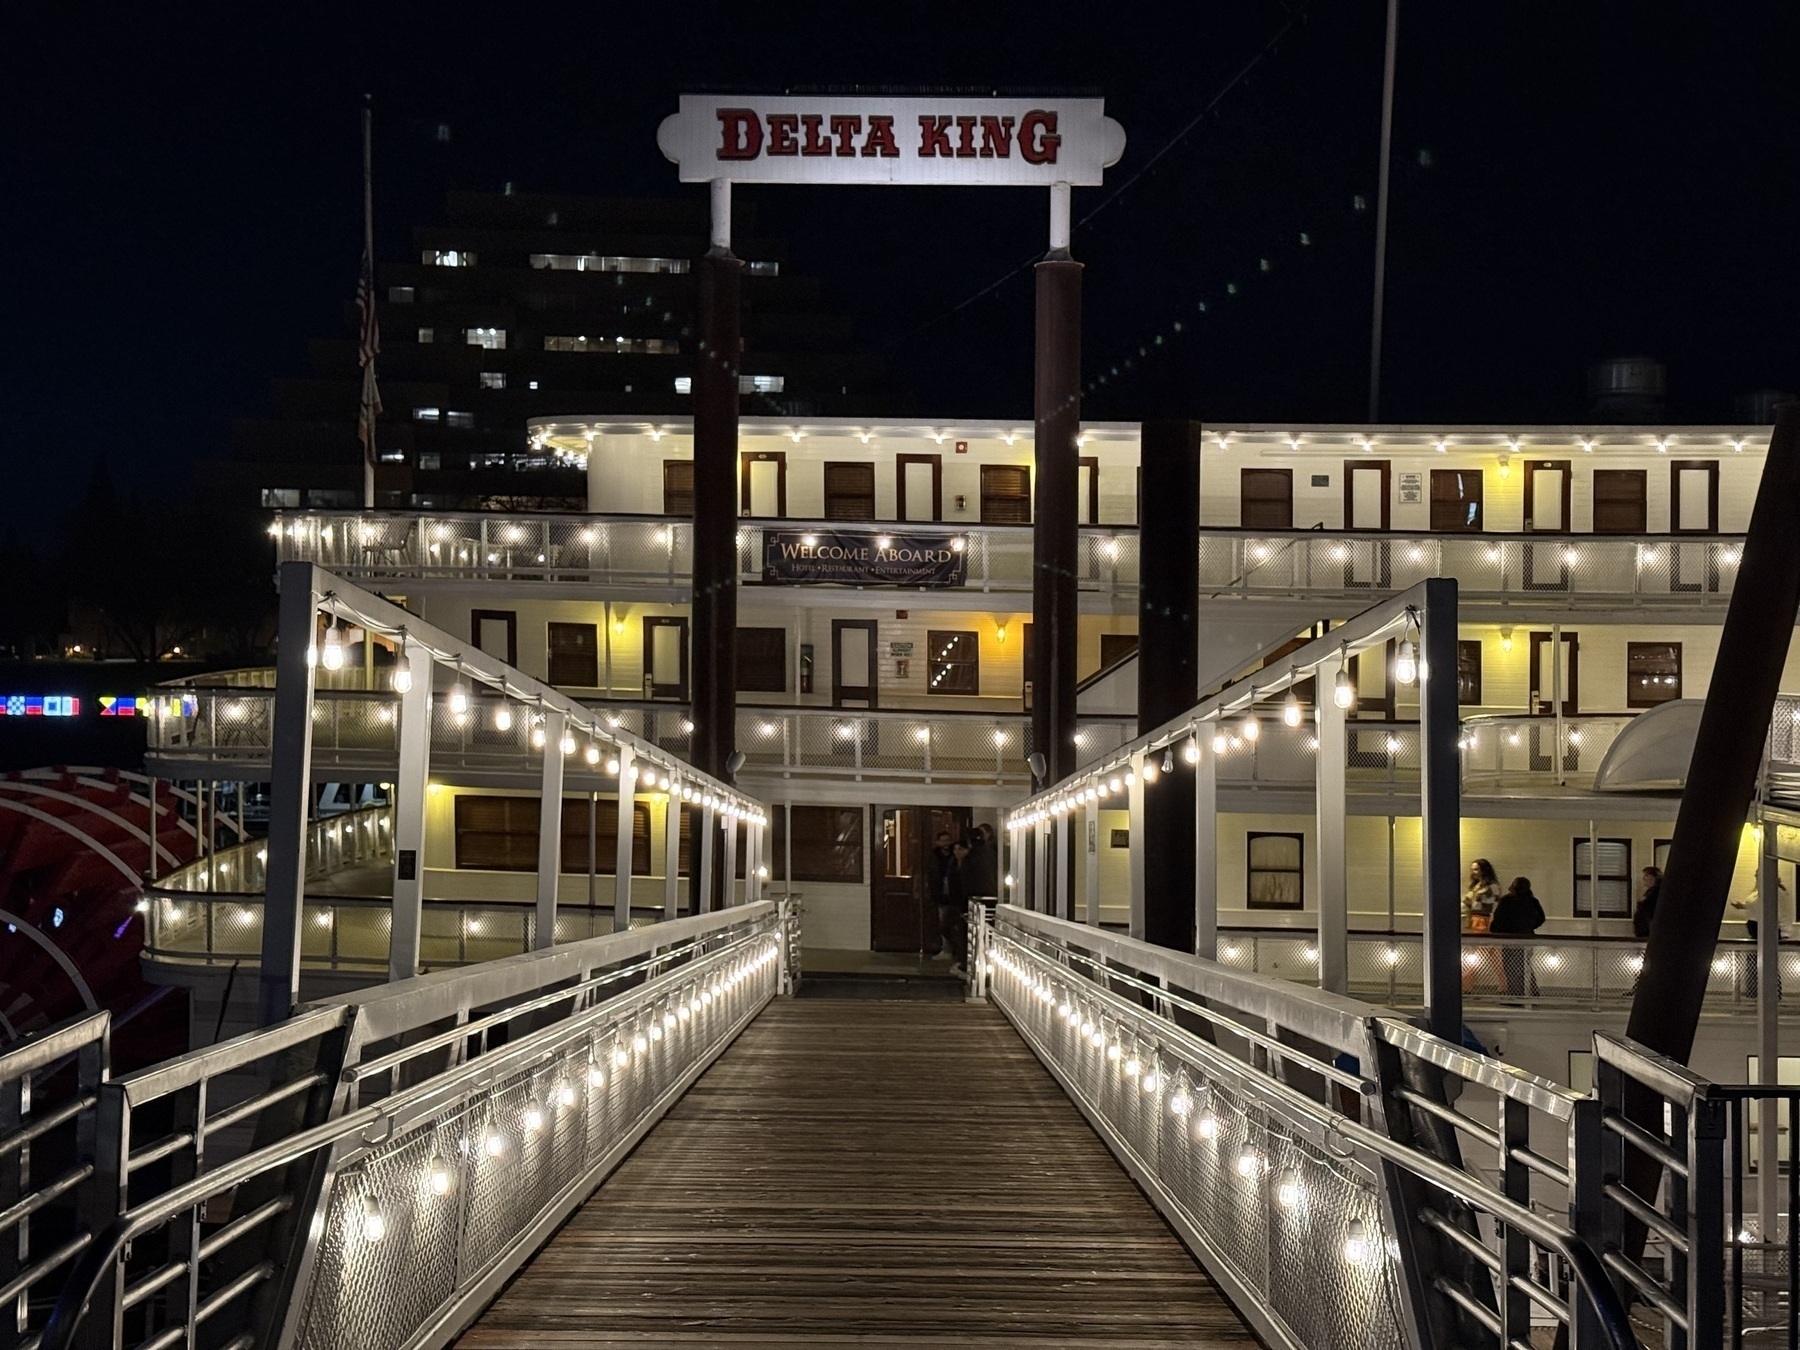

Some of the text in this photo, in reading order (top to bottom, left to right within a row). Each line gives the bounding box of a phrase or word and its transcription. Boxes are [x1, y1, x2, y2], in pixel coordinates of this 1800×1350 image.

[715, 108, 1062, 164] DELTA KING
[780, 543, 952, 563] WELCOME ABOARD
[791, 563, 936, 575] HOTEL RESTAURANT ENTERTAINMENT
